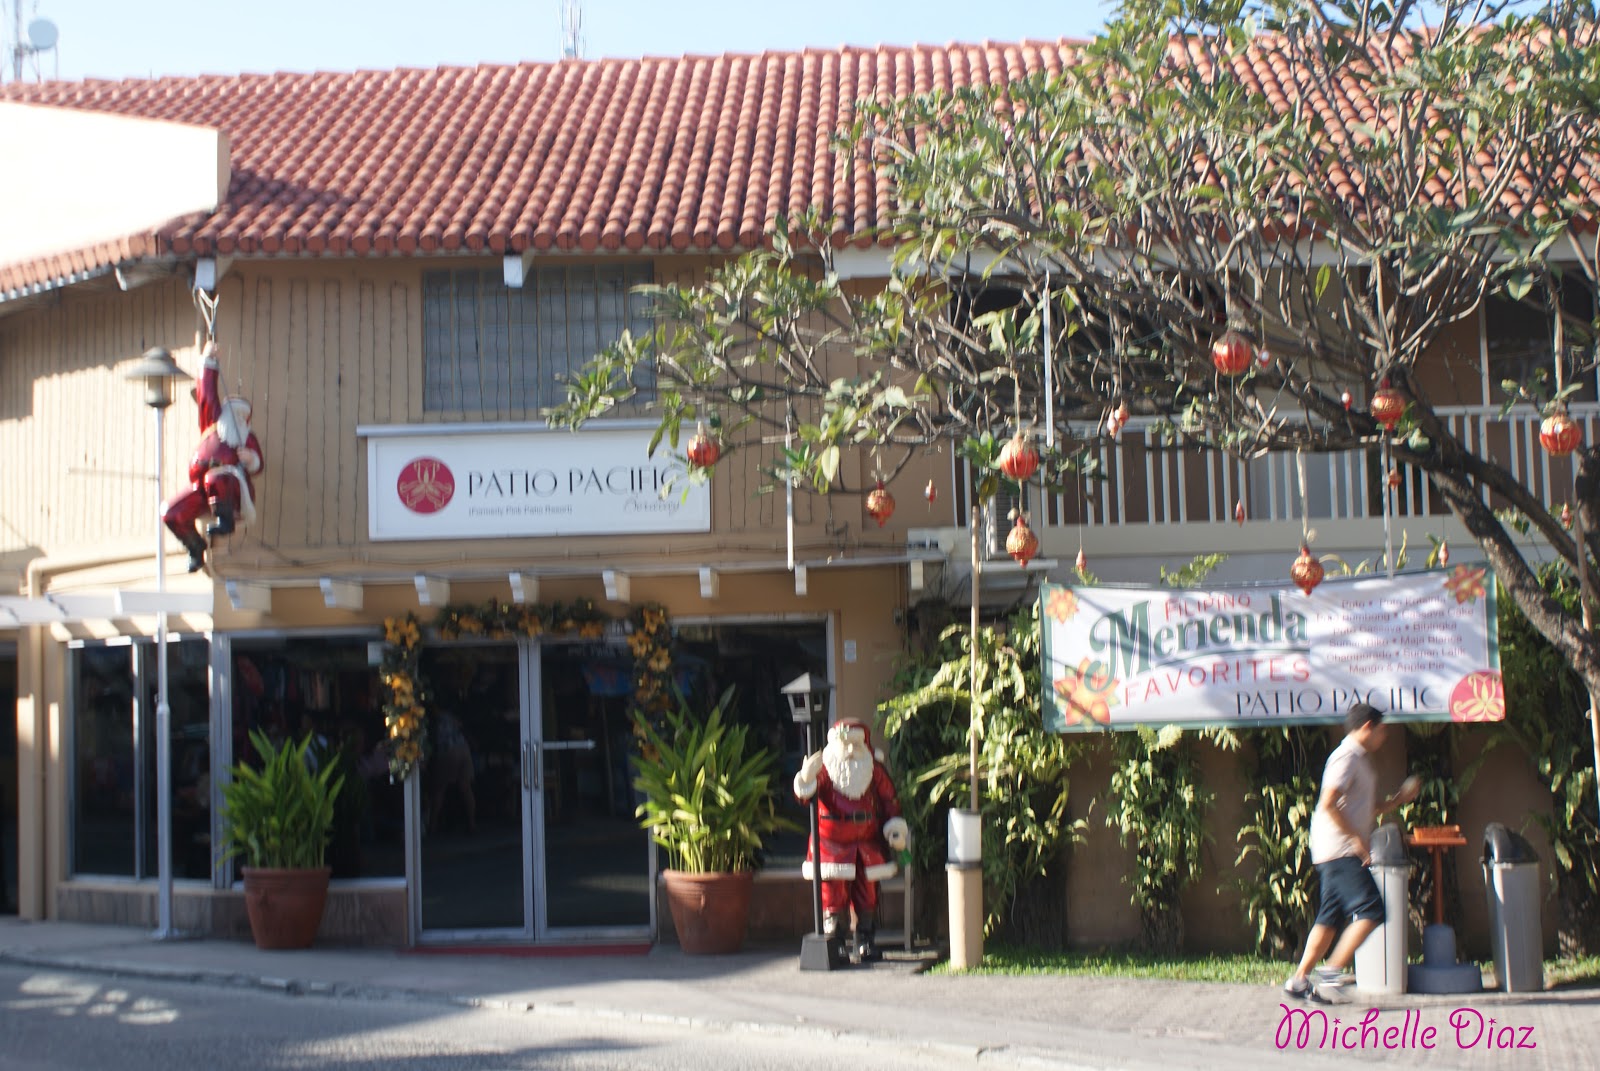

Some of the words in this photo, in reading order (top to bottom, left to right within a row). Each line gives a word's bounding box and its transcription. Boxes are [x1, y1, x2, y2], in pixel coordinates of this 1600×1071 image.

[468, 468, 558, 498] PATIO
[569, 463, 684, 496] PACIFIC
[1084, 592, 1309, 693] Merienda
[1125, 655, 1310, 707] FAVORITES
[1236, 687, 1322, 715] PATIO
[1333, 684, 1443, 713] PACIFIC
